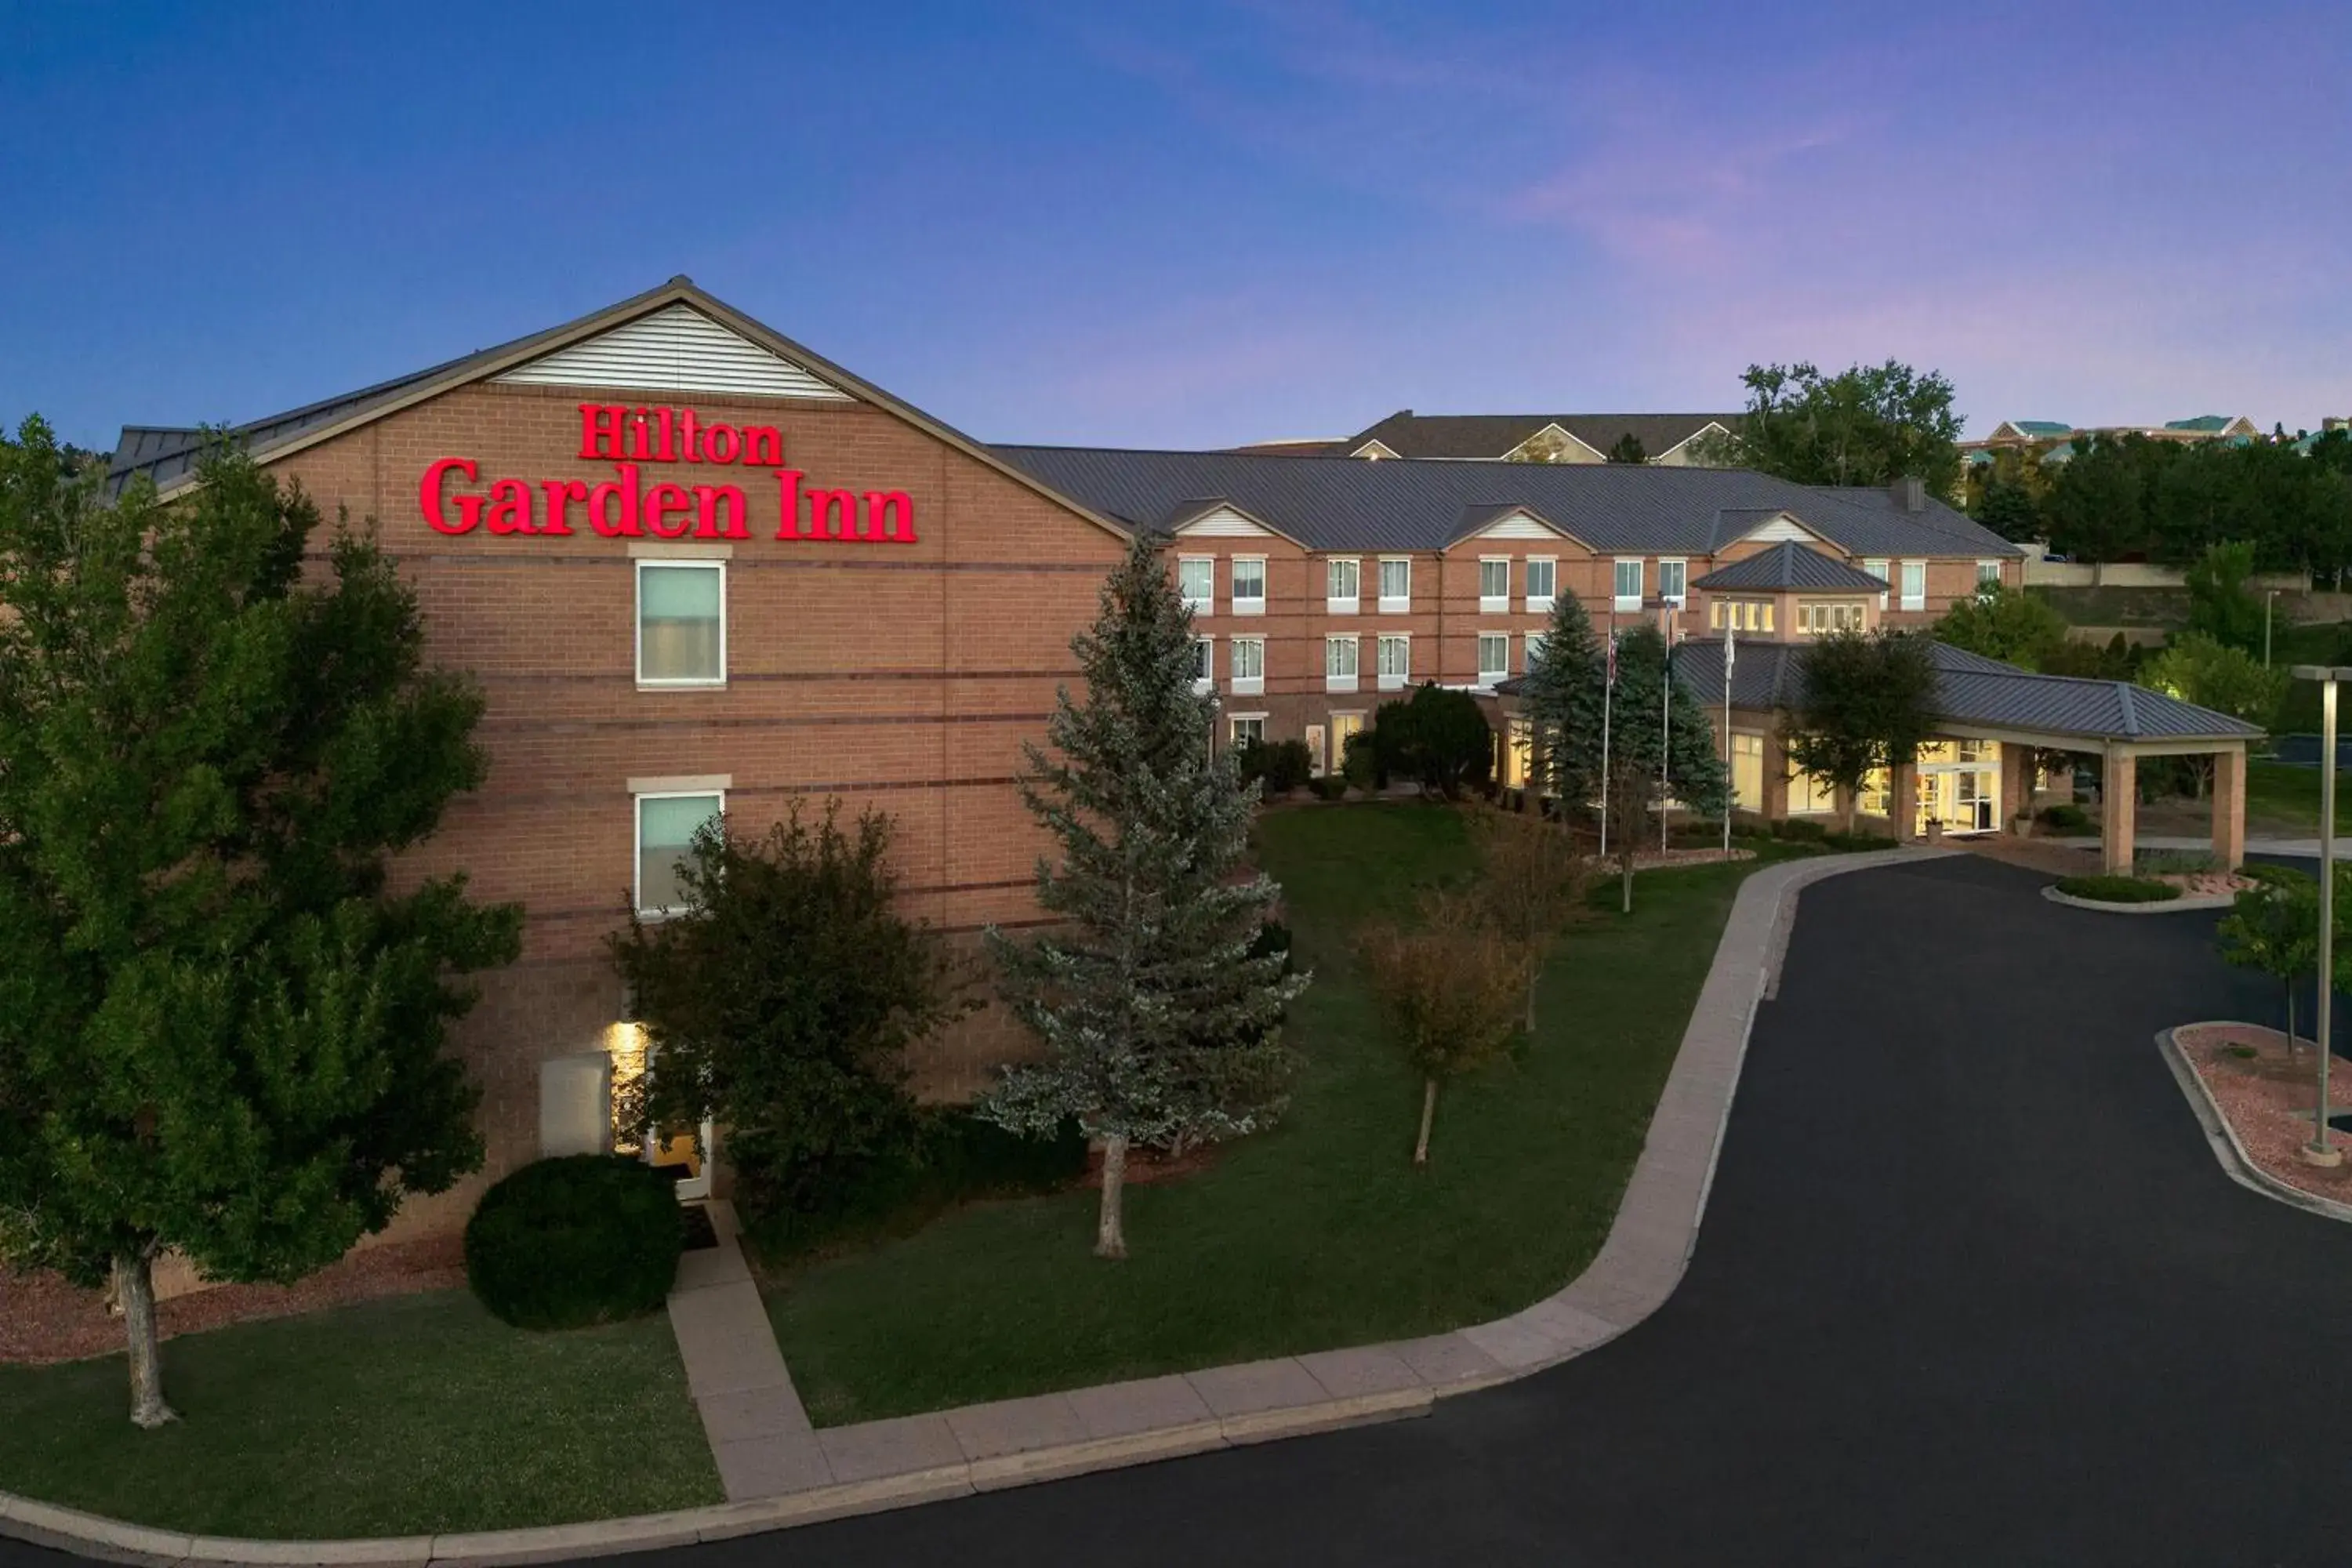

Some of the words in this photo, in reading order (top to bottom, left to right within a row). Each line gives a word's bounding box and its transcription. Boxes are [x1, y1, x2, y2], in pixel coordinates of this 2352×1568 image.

[578, 404, 785, 466] Hilton
[419, 458, 751, 540] Garden
[774, 470, 917, 543] Inn
